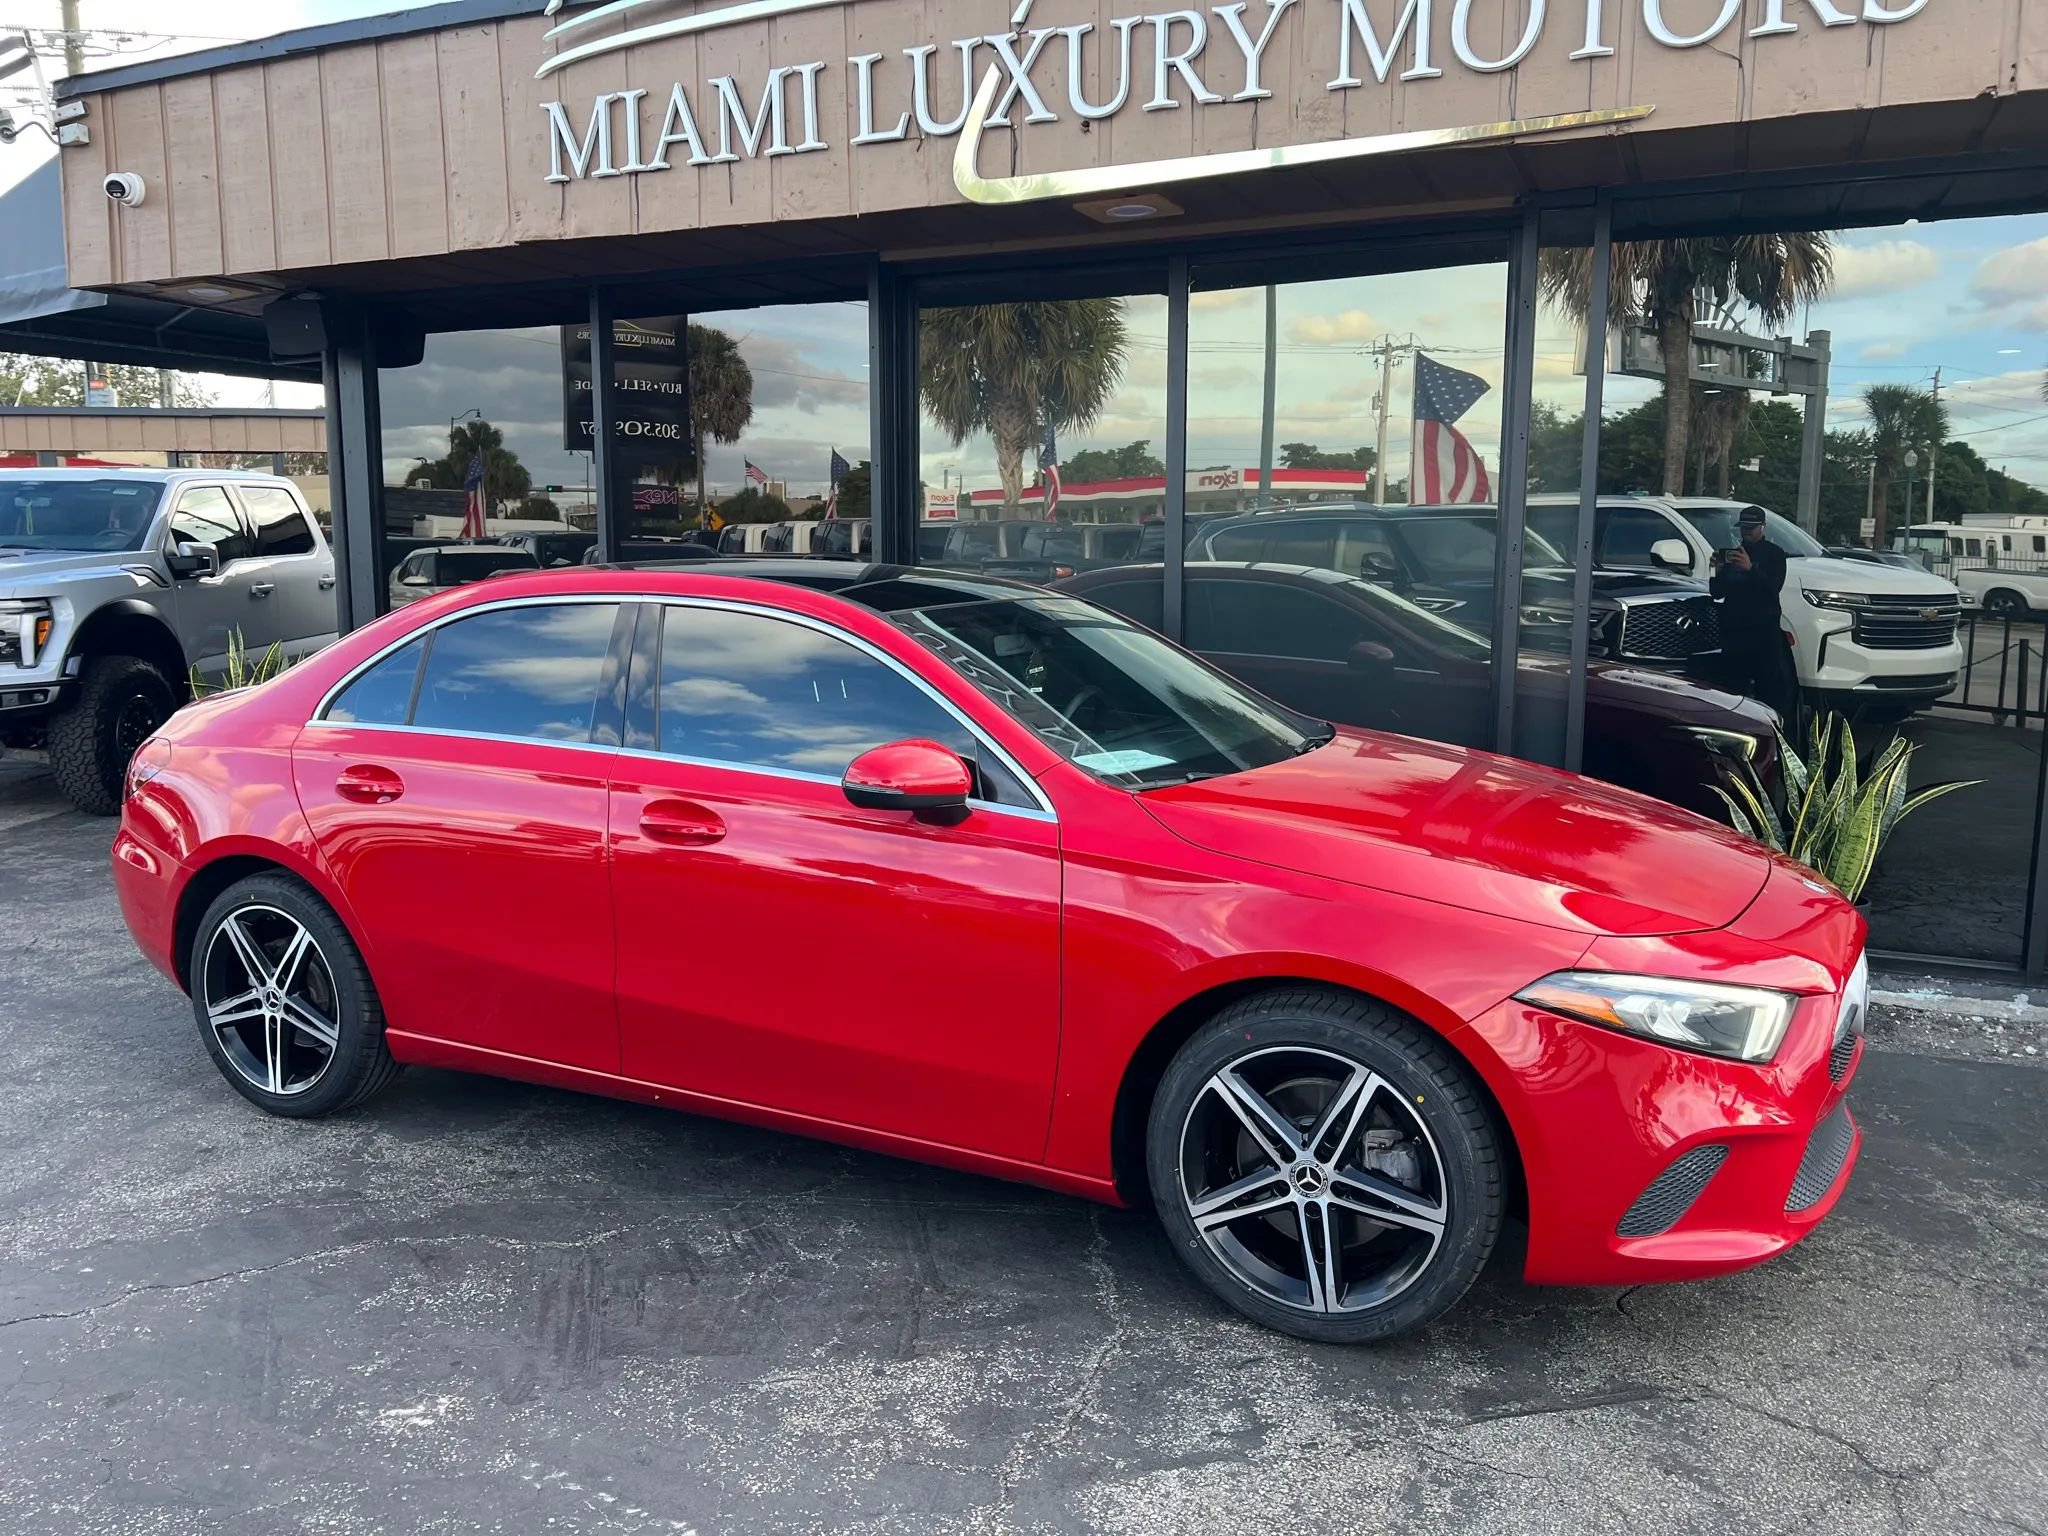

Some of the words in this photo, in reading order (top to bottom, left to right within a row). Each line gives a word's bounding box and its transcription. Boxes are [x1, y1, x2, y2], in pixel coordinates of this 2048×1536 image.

[540, 61, 828, 184] MIAMI
[848, 0, 1298, 146] LUXURY
[1326, 0, 1931, 90] MOT
